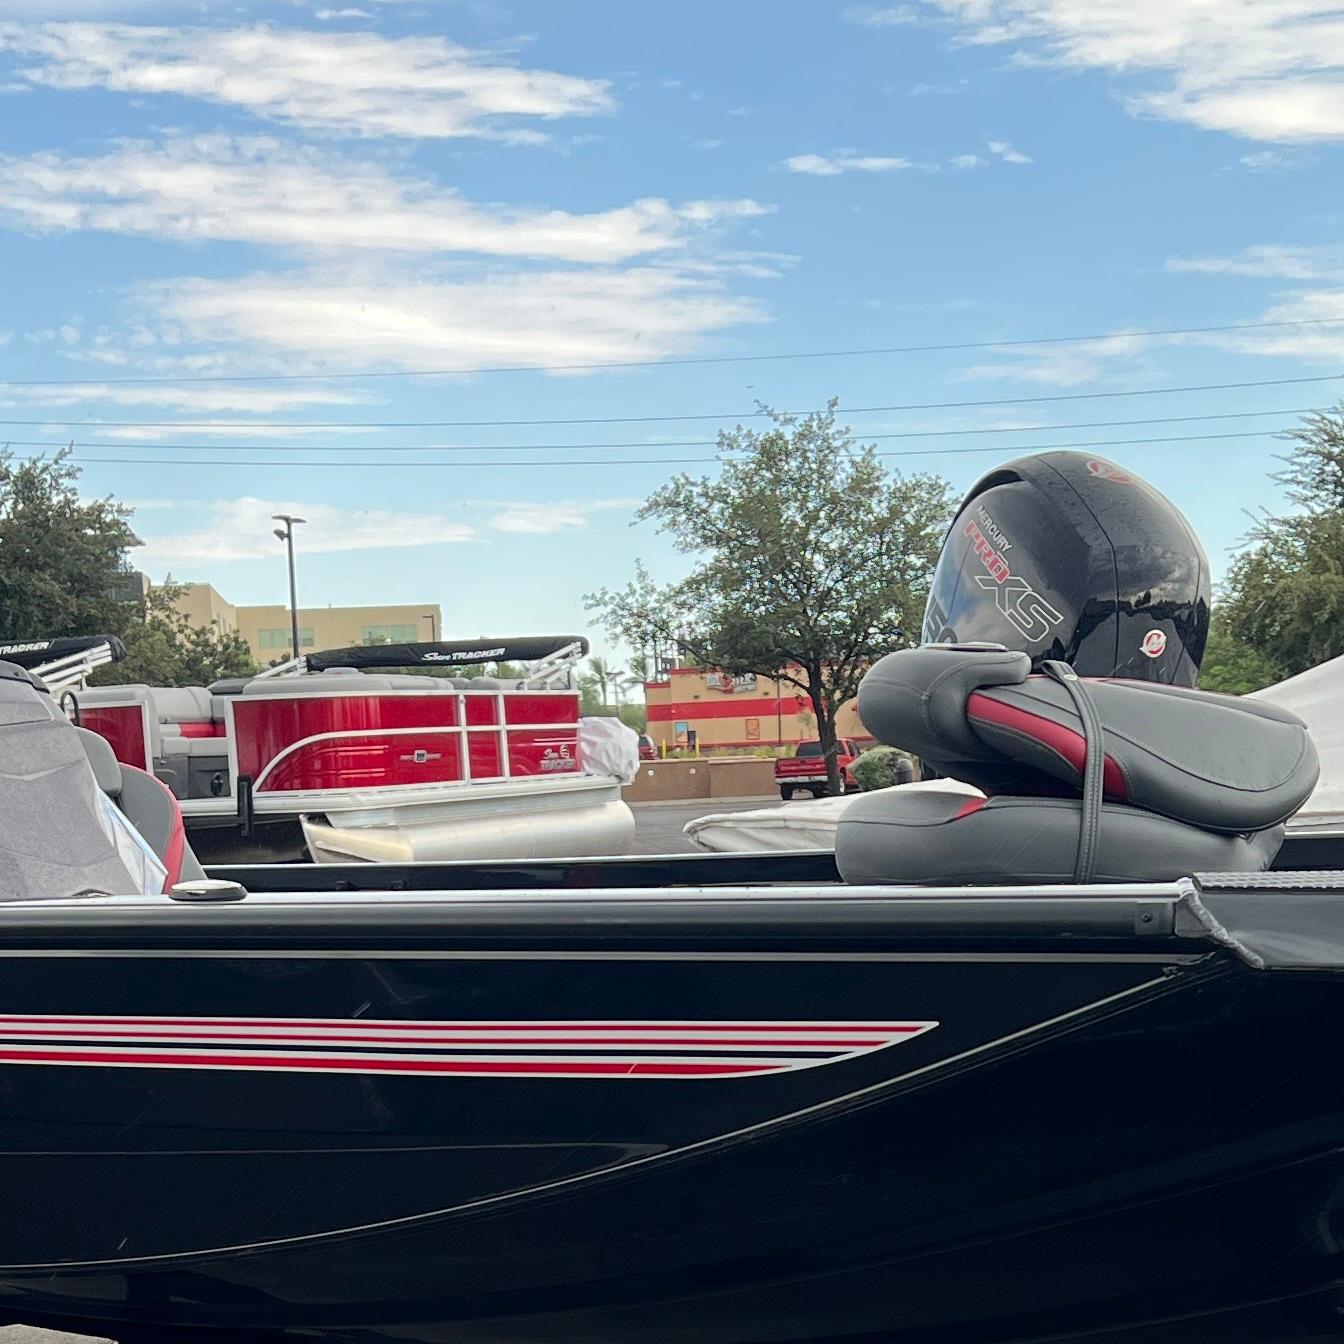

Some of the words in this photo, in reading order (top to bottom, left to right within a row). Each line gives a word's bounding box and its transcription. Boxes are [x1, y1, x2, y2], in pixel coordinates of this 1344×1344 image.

[963, 520, 1012, 584] PRO
[975, 505, 1013, 552] MERCURY
[974, 575, 1064, 642] XS
[452, 647, 506, 661] TRACKER
